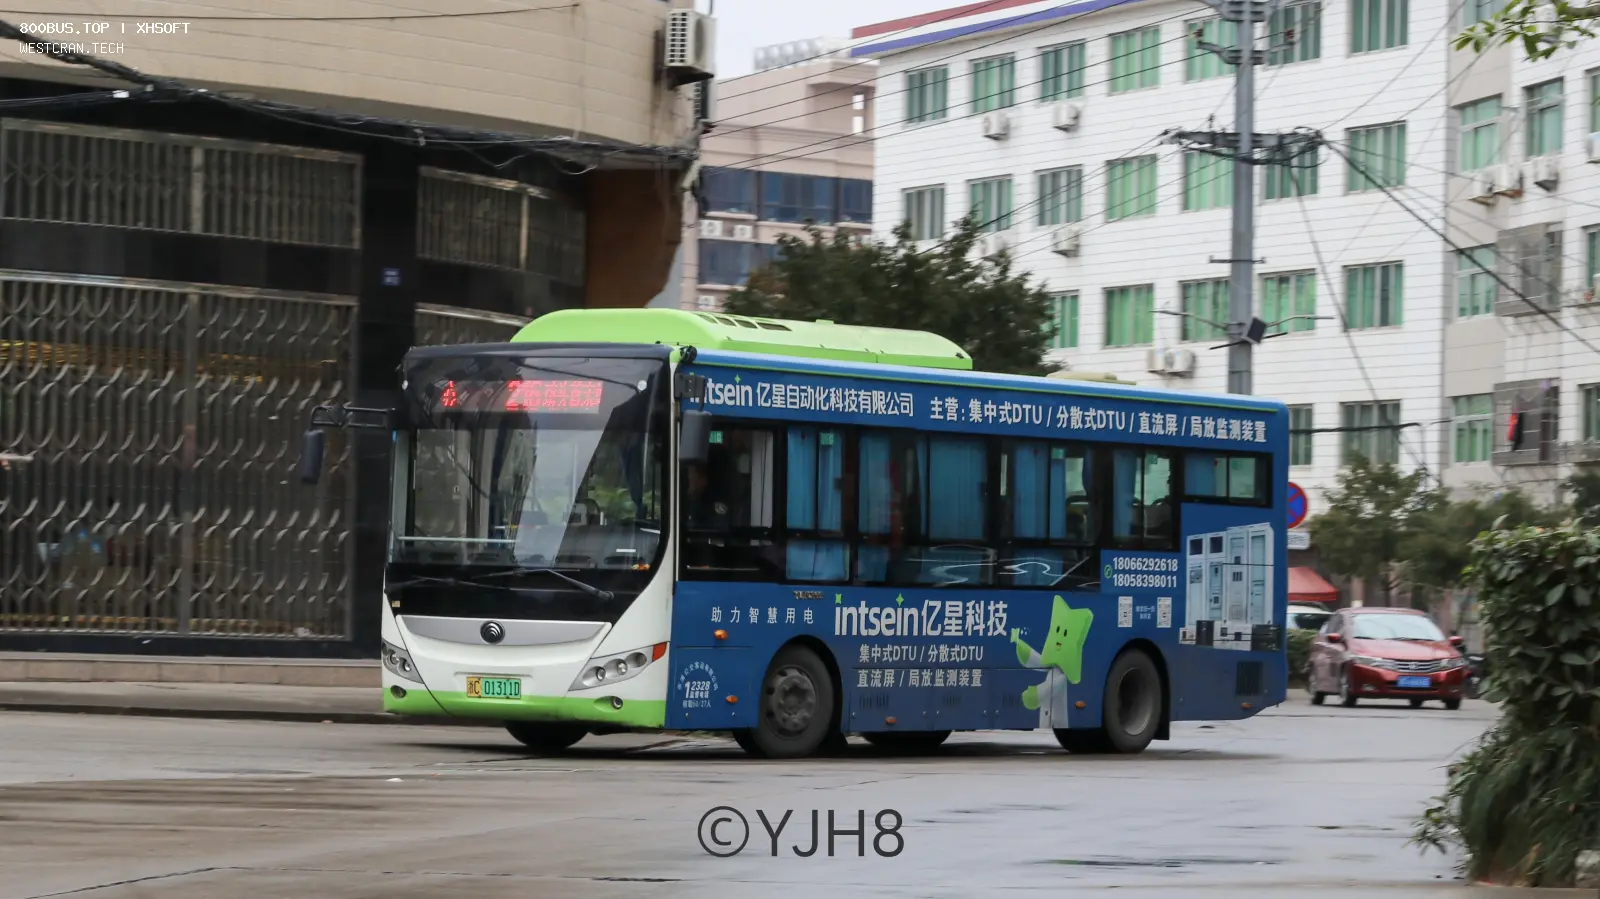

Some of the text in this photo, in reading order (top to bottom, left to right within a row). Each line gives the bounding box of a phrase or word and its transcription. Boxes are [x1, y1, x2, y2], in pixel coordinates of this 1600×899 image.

[689, 372, 914, 417] tsein 亿星自动化科技有限公司
[1056, 405, 1125, 431] 分散式DTU
[1138, 411, 1178, 436] 直流屏
[1190, 415, 1267, 443] 局放监测装置
[1113, 556, 1178, 571] 18066292618
[1113, 574, 1177, 588] 18058398011
[711, 606, 814, 624] 助力智慧用电
[834, 593, 1008, 637] intsein 亿星科技
[859, 643, 917, 663] 集中式DTU
[928, 643, 983, 663] 分散式DTU
[857, 669, 895, 688] 直流屏
[908, 668, 982, 688] 局放监测装置
